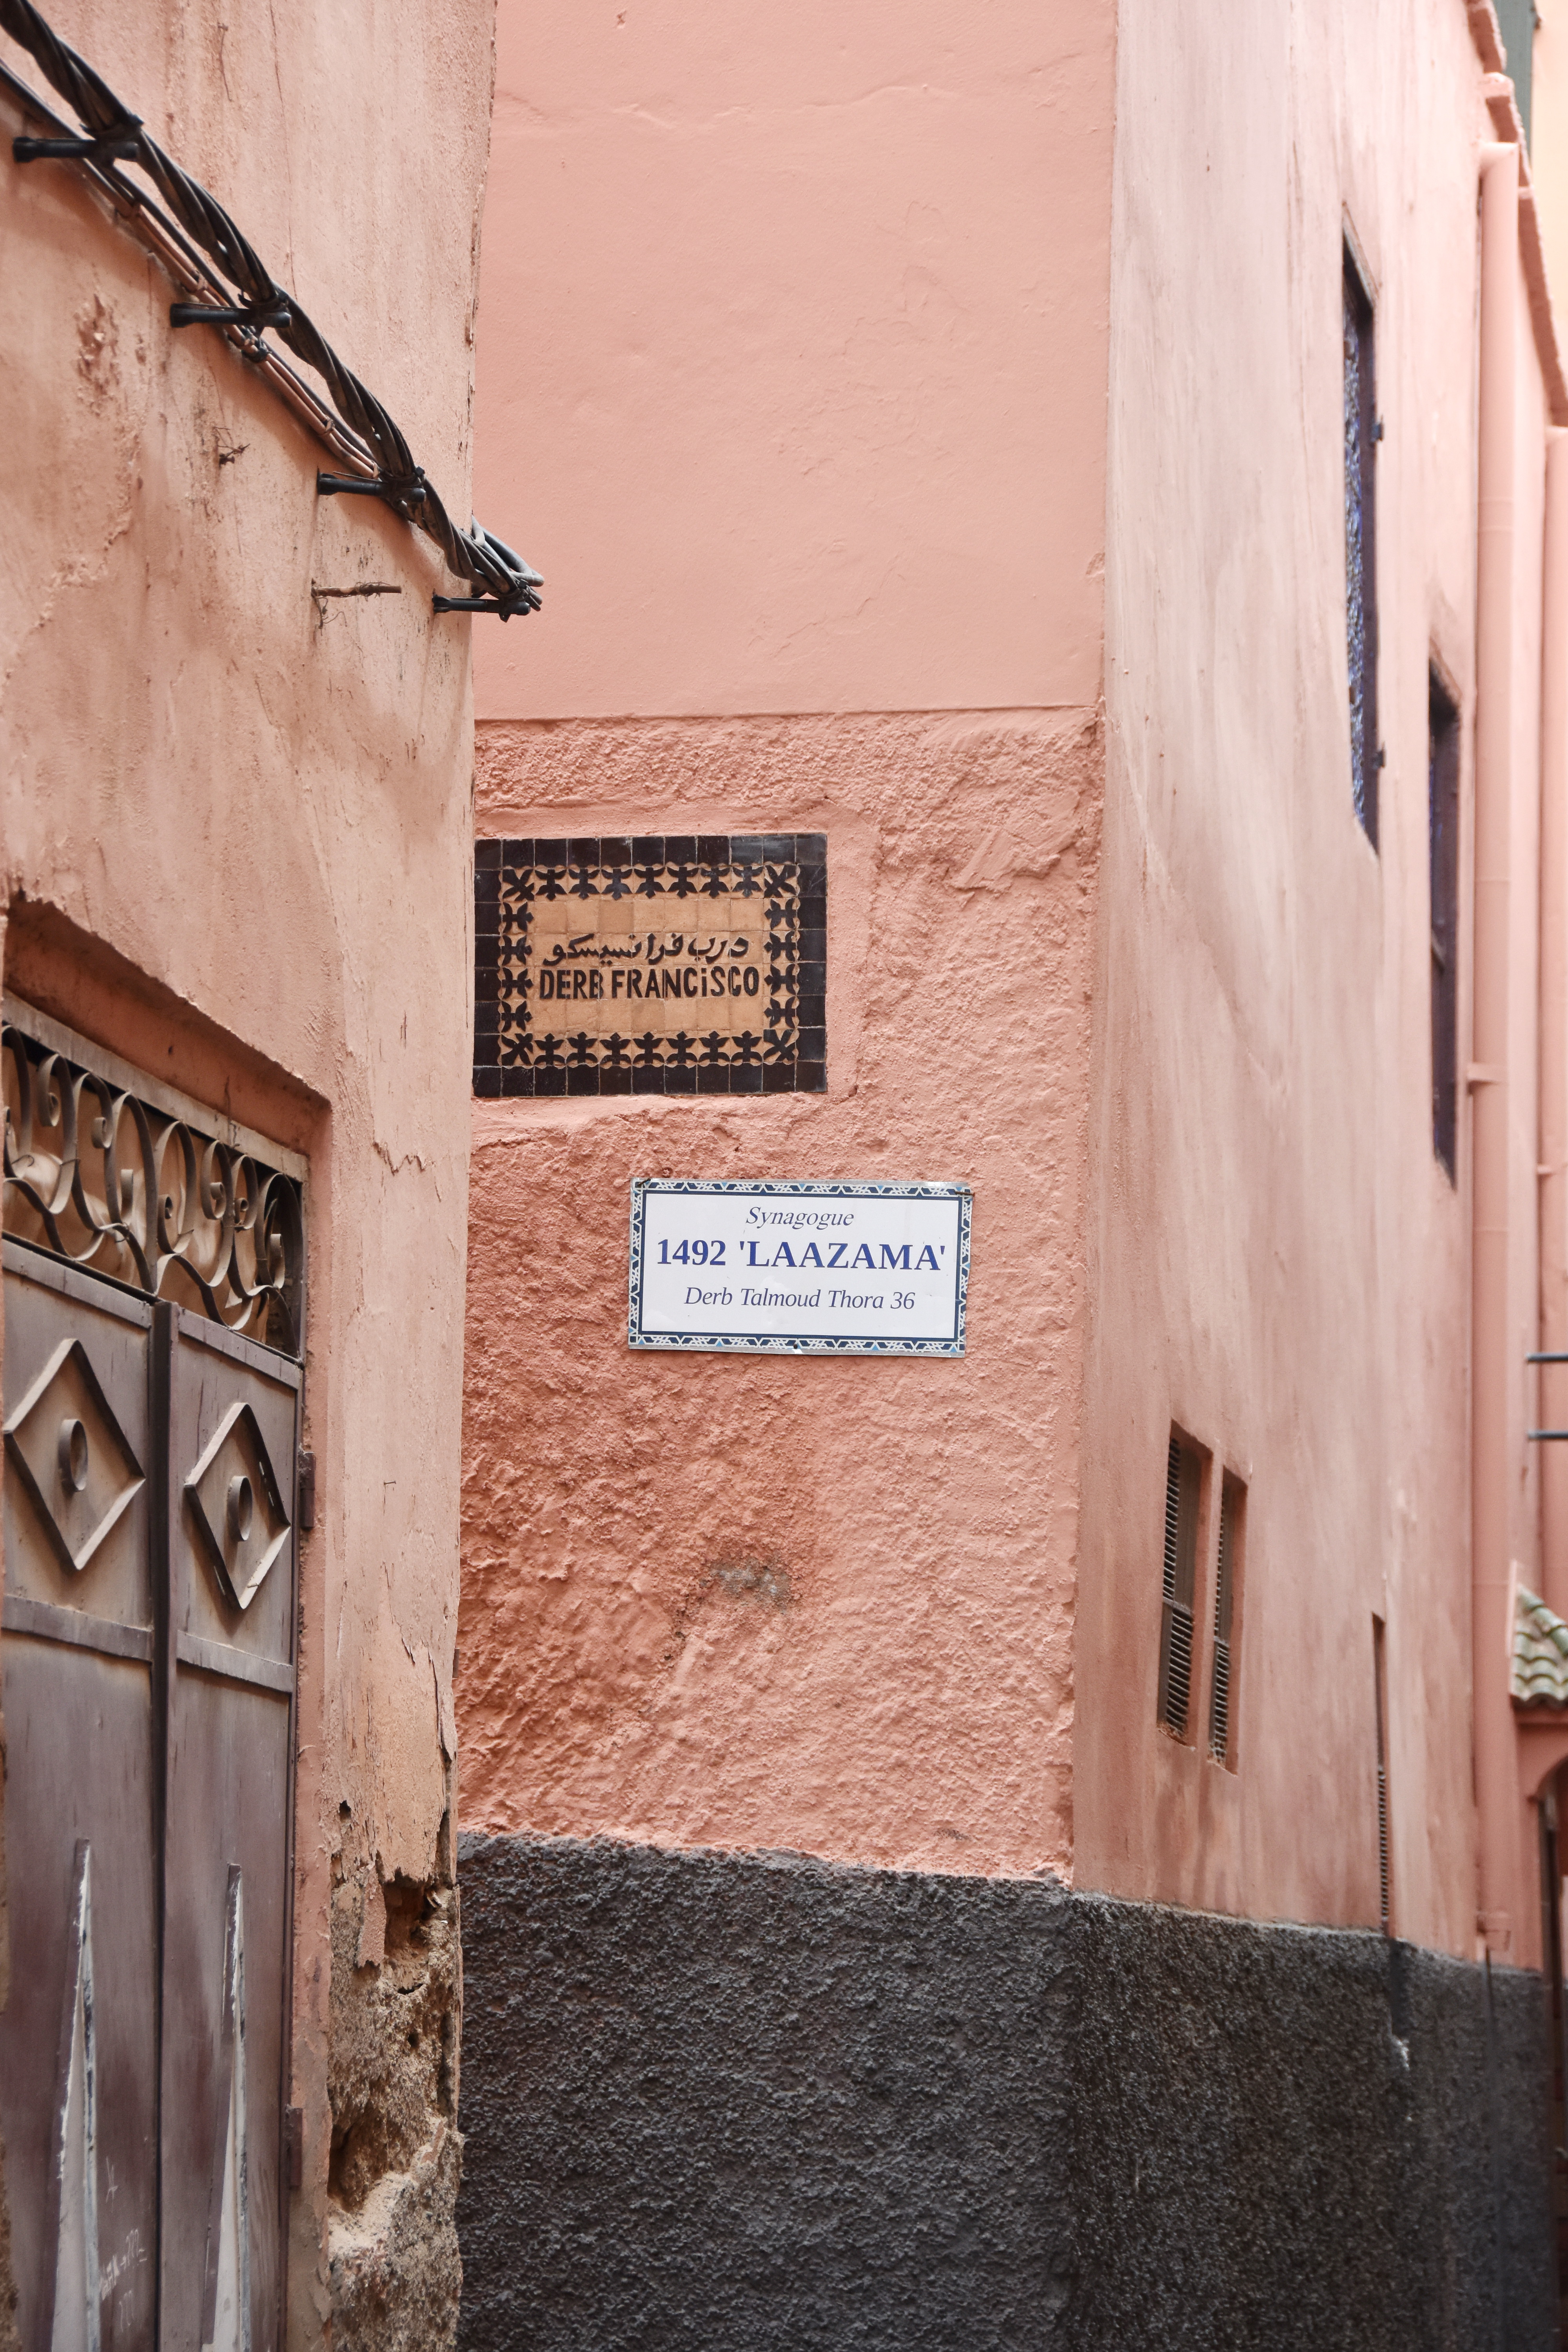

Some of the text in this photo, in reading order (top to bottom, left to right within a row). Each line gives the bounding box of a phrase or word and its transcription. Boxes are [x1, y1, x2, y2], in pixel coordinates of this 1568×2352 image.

[543, 933, 749, 967] درب فرانسيسكو
[539, 969, 604, 1000] DERB
[746, 1207, 854, 1230] Synagogue
[657, 1239, 945, 1270] 1492 'LAAZAMA'
[684, 1287, 915, 1309] Derb Talmoud Thora 36
